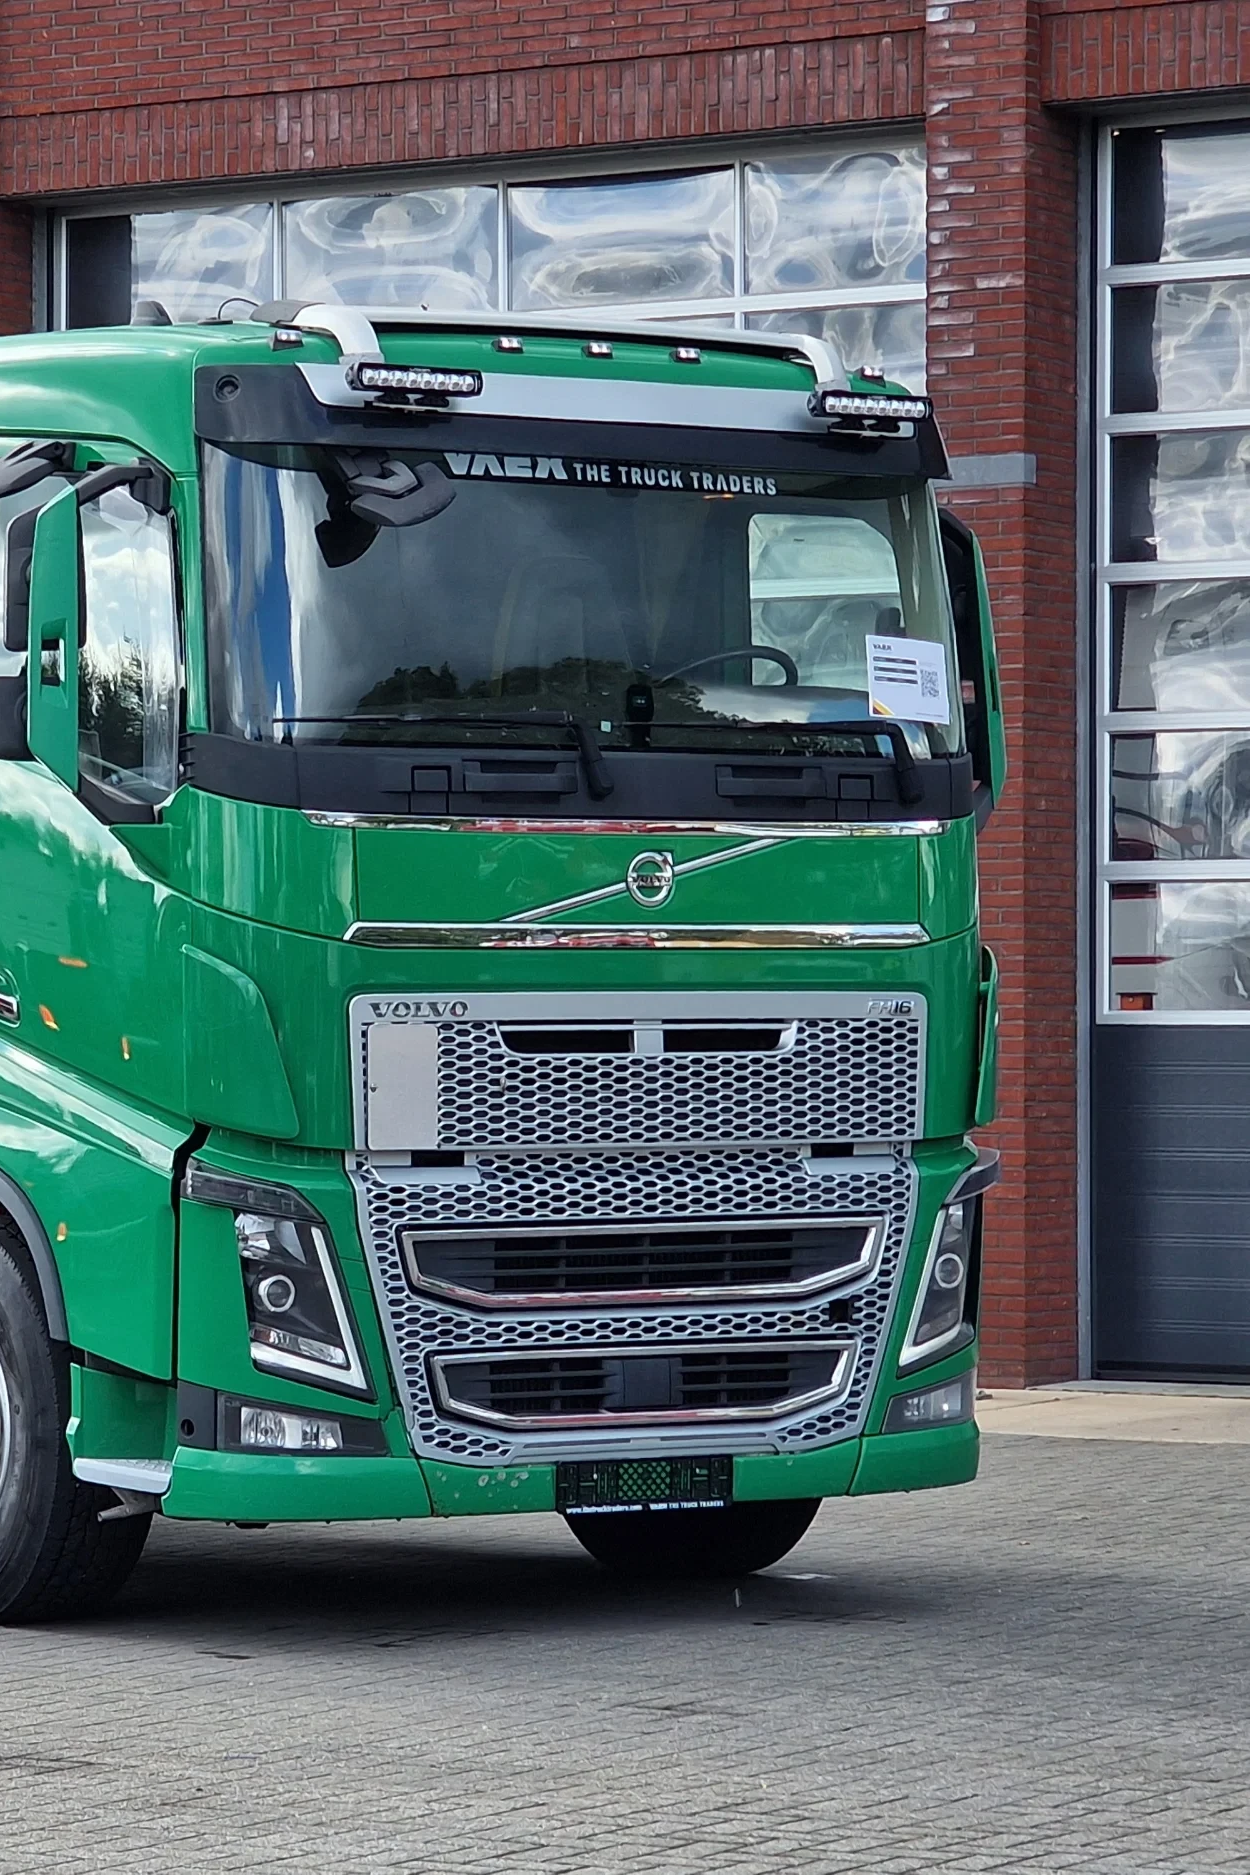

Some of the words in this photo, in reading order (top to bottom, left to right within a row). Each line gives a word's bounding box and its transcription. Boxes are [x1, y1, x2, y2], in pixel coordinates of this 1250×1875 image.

[443, 452, 568, 480] VAEX
[573, 463, 611, 483] THE
[618, 466, 684, 489] TRUCK
[690, 471, 777, 496] TRADERS
[368, 1001, 469, 1018] VOLVO
[867, 1000, 914, 1016] FH16
